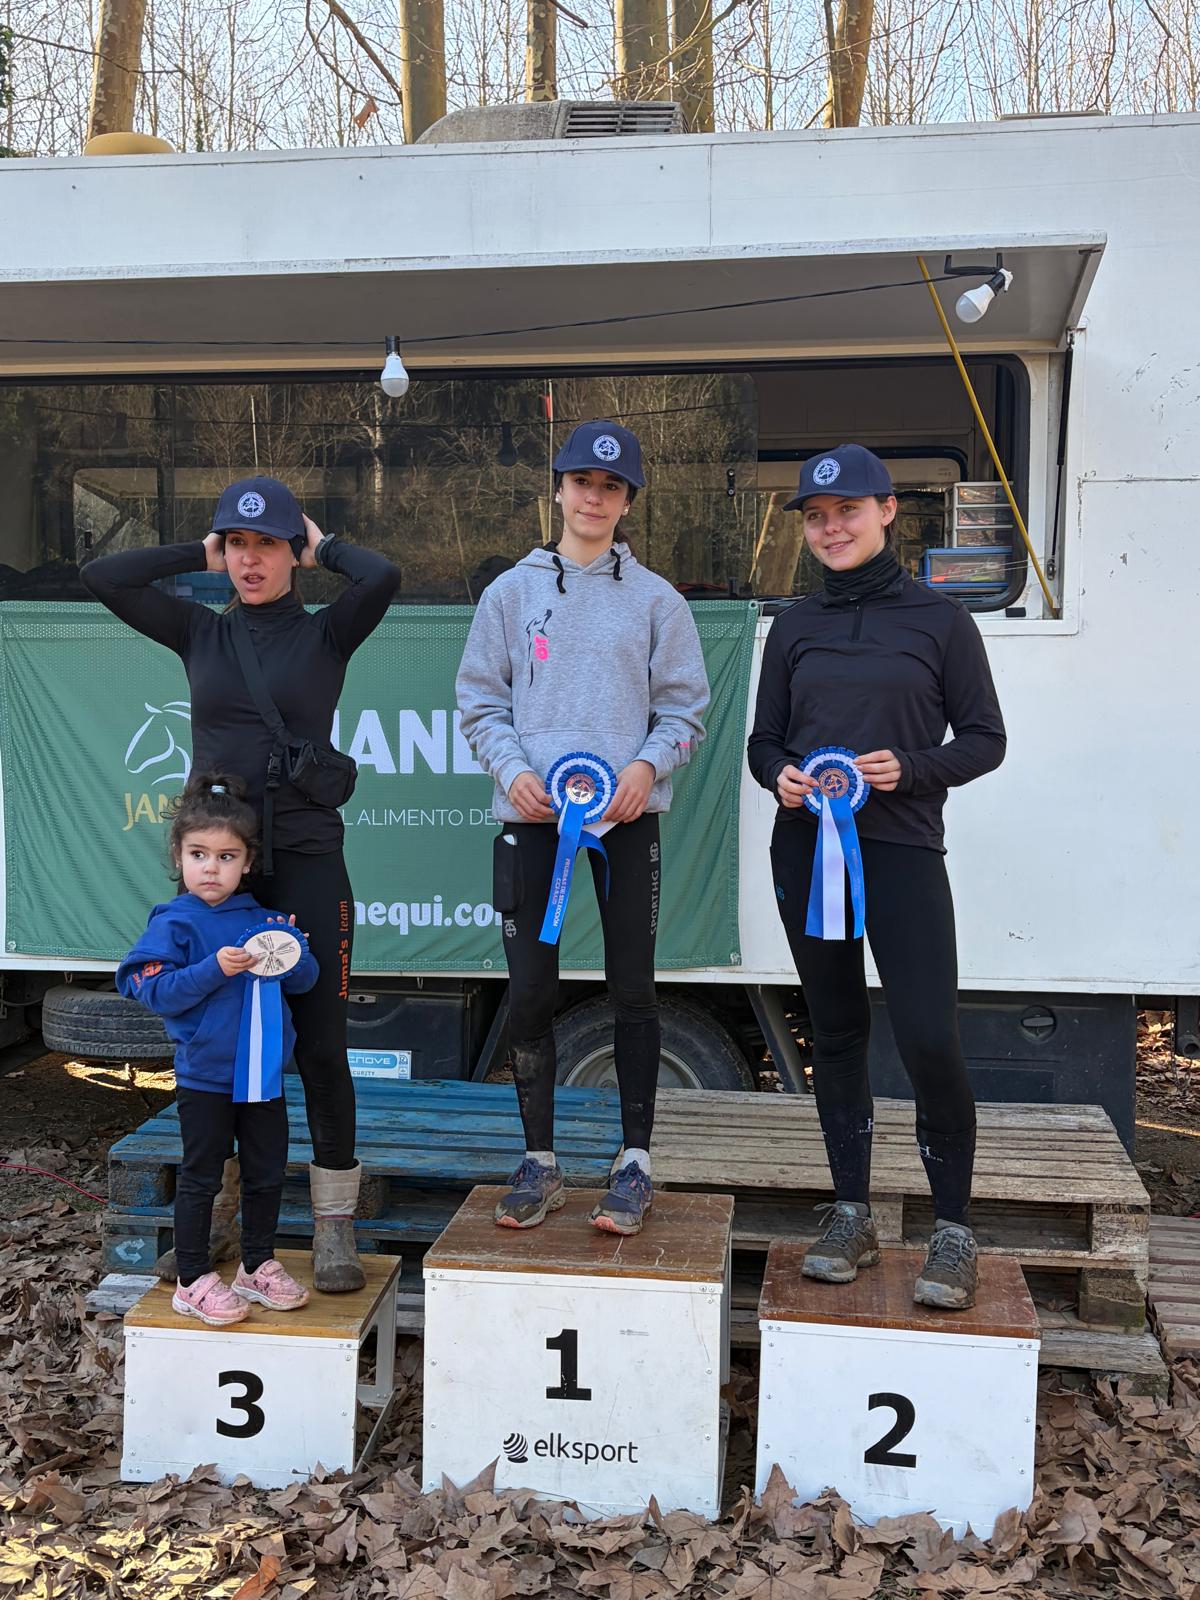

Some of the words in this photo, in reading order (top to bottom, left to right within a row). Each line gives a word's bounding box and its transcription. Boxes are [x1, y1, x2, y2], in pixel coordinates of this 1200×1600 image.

[330, 709, 492, 774] AN
[357, 808, 464, 826] ALIMENTO
[469, 808, 504, 826] DE
[339, 900, 349, 932] team
[338, 939, 349, 1000] Juma's
[545, 1329, 593, 1401] 1
[215, 1370, 266, 1439] 3
[863, 1392, 918, 1469] 2
[534, 1432, 639, 1465] elksport
